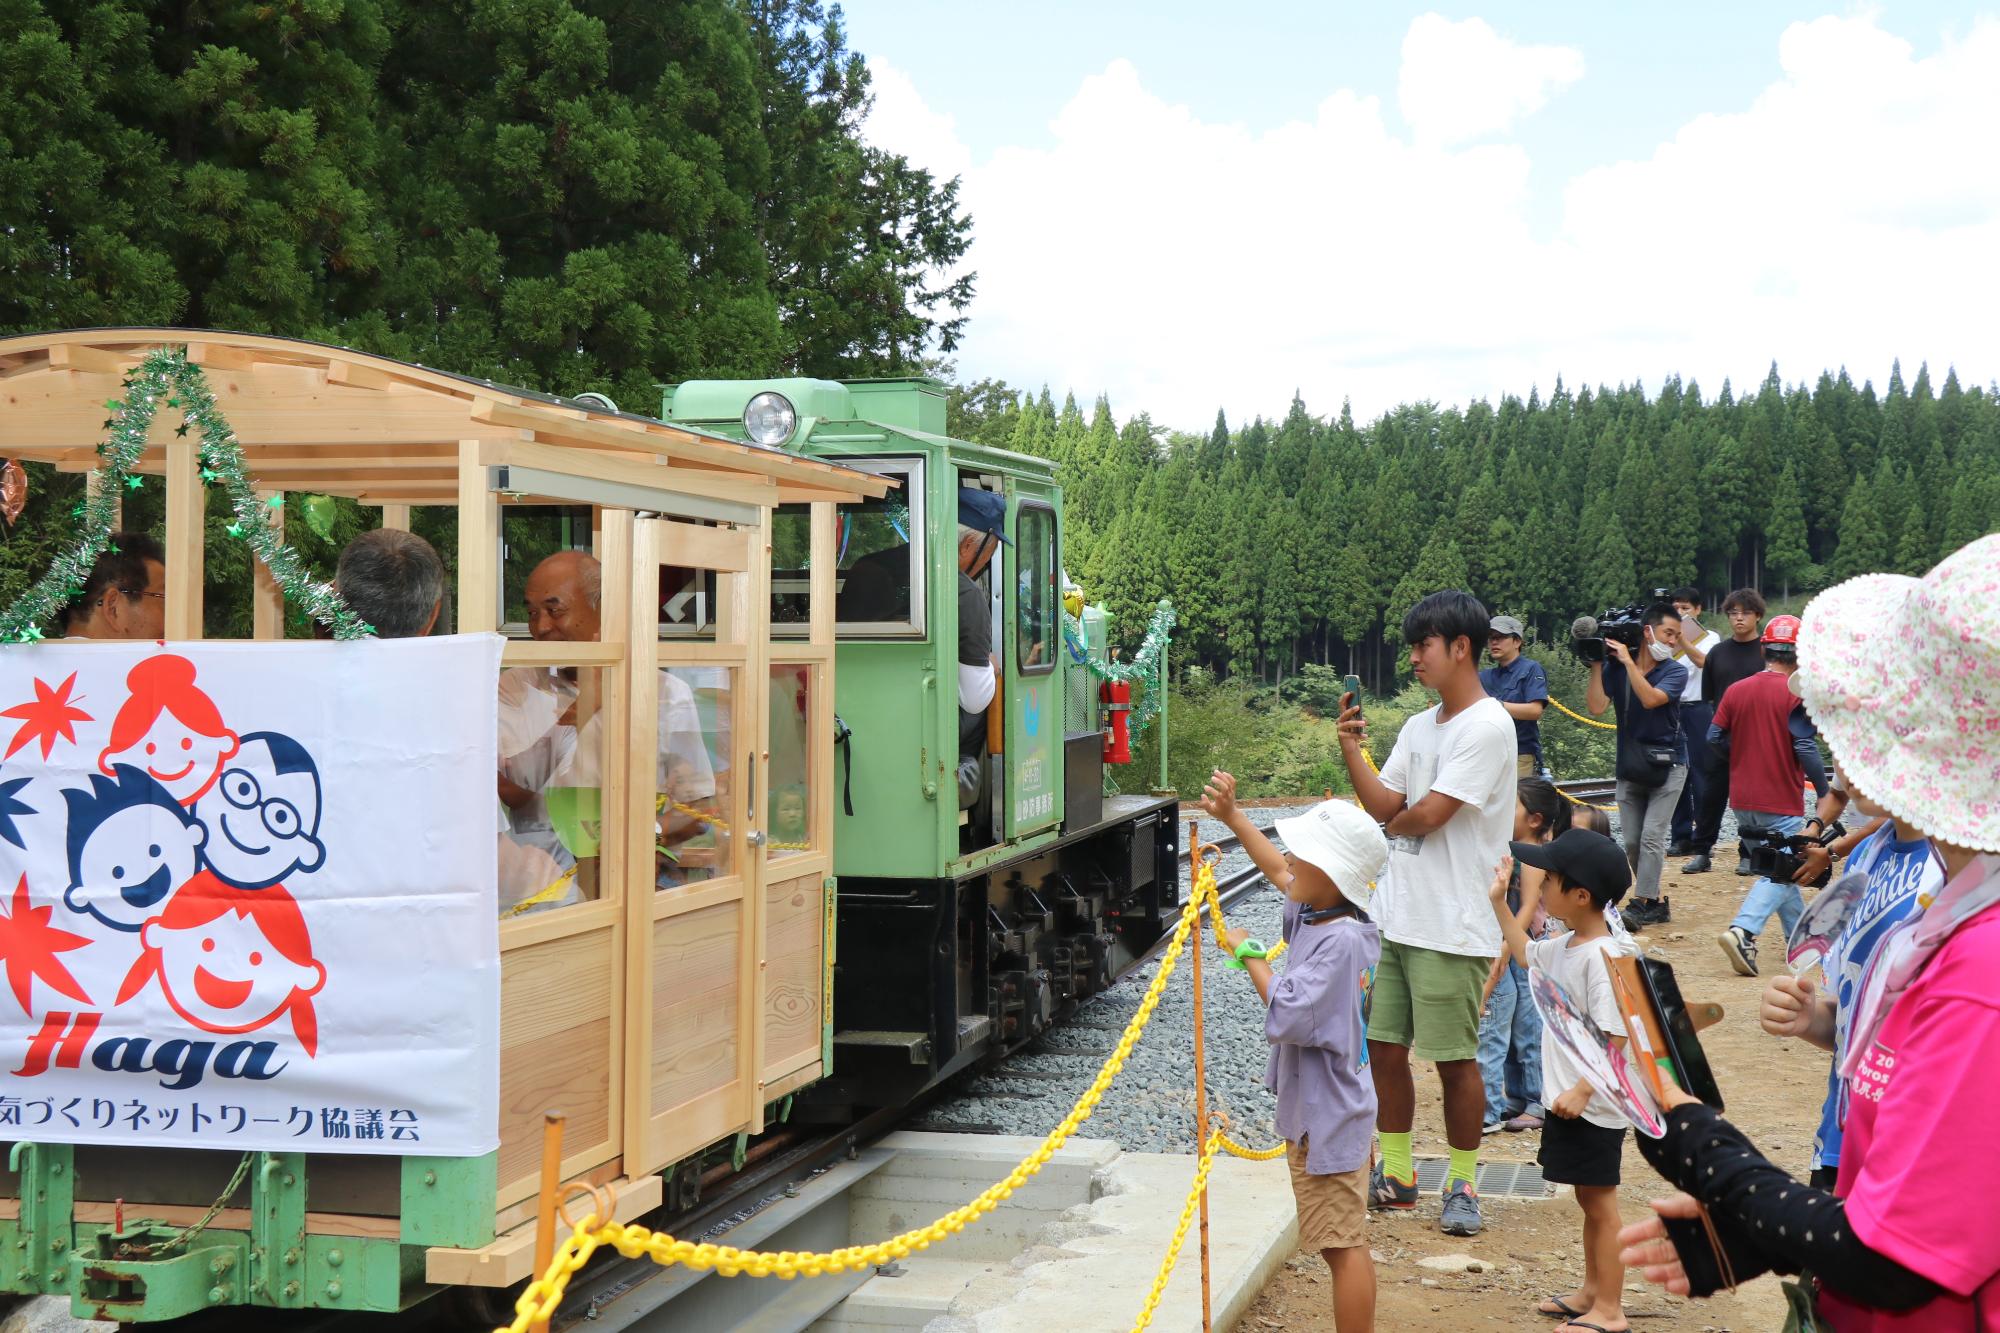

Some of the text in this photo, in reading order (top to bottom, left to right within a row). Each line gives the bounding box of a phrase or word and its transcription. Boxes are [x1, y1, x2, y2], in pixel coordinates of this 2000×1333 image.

[10, 1011, 289, 1090] Haga
[0, 1095, 420, 1141] 気づくりネットワーク協議会
